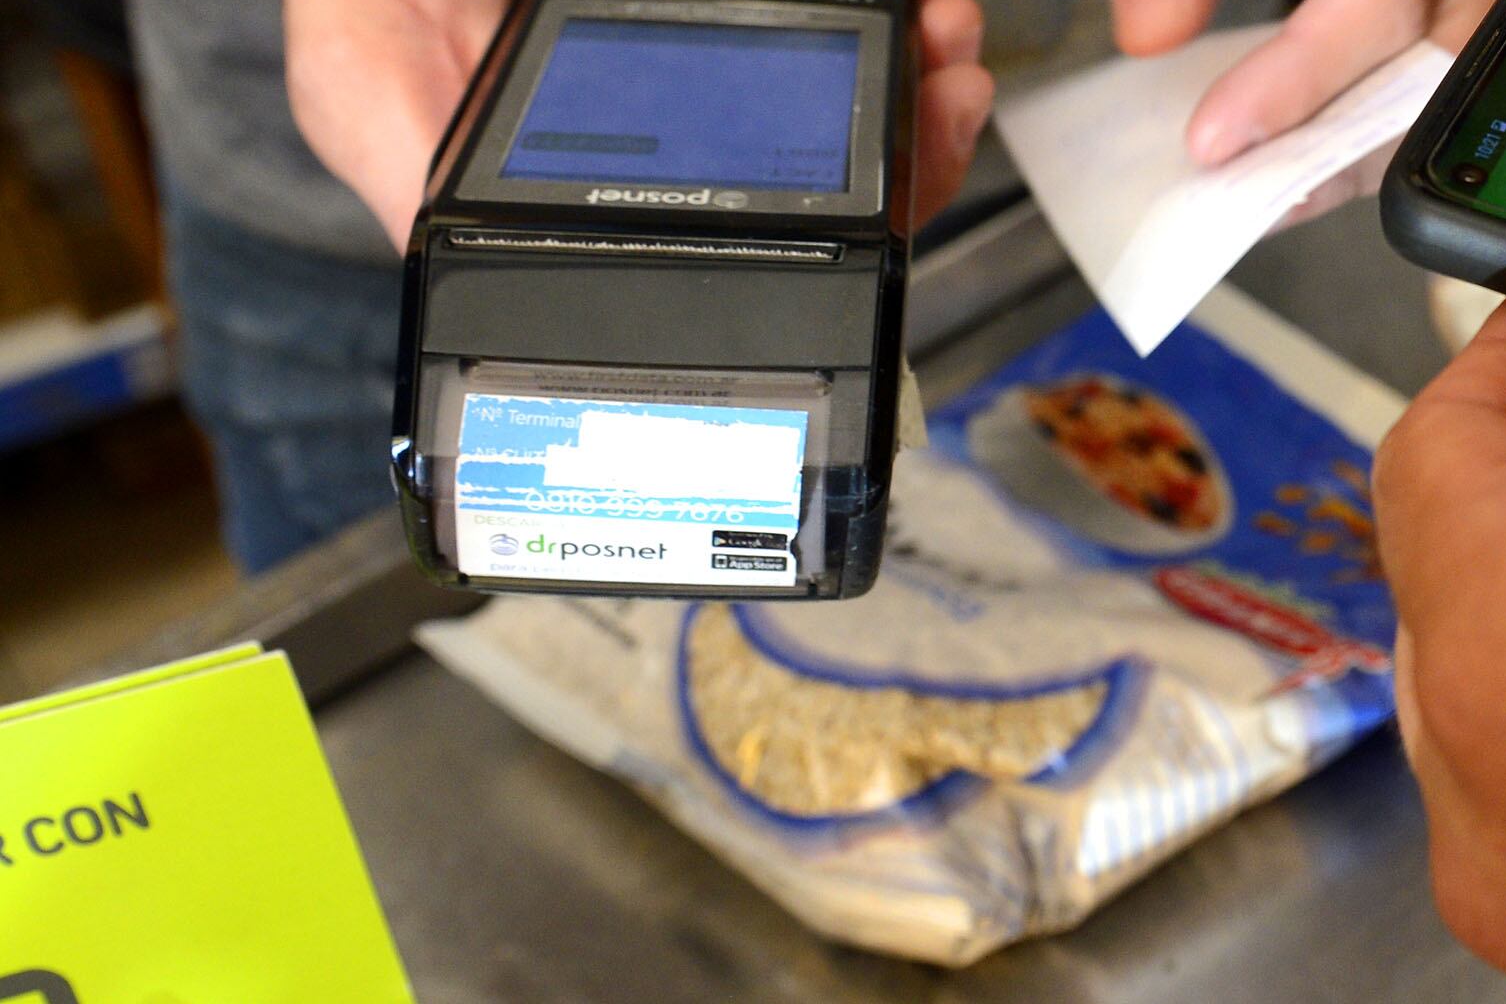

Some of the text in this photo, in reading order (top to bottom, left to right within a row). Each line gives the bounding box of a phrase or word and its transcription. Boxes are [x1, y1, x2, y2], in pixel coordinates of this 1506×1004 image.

[585, 188, 712, 206] posnet
[507, 409, 581, 429] Terminal
[526, 534, 668, 560] drposnet
[23, 792, 150, 855] CON
